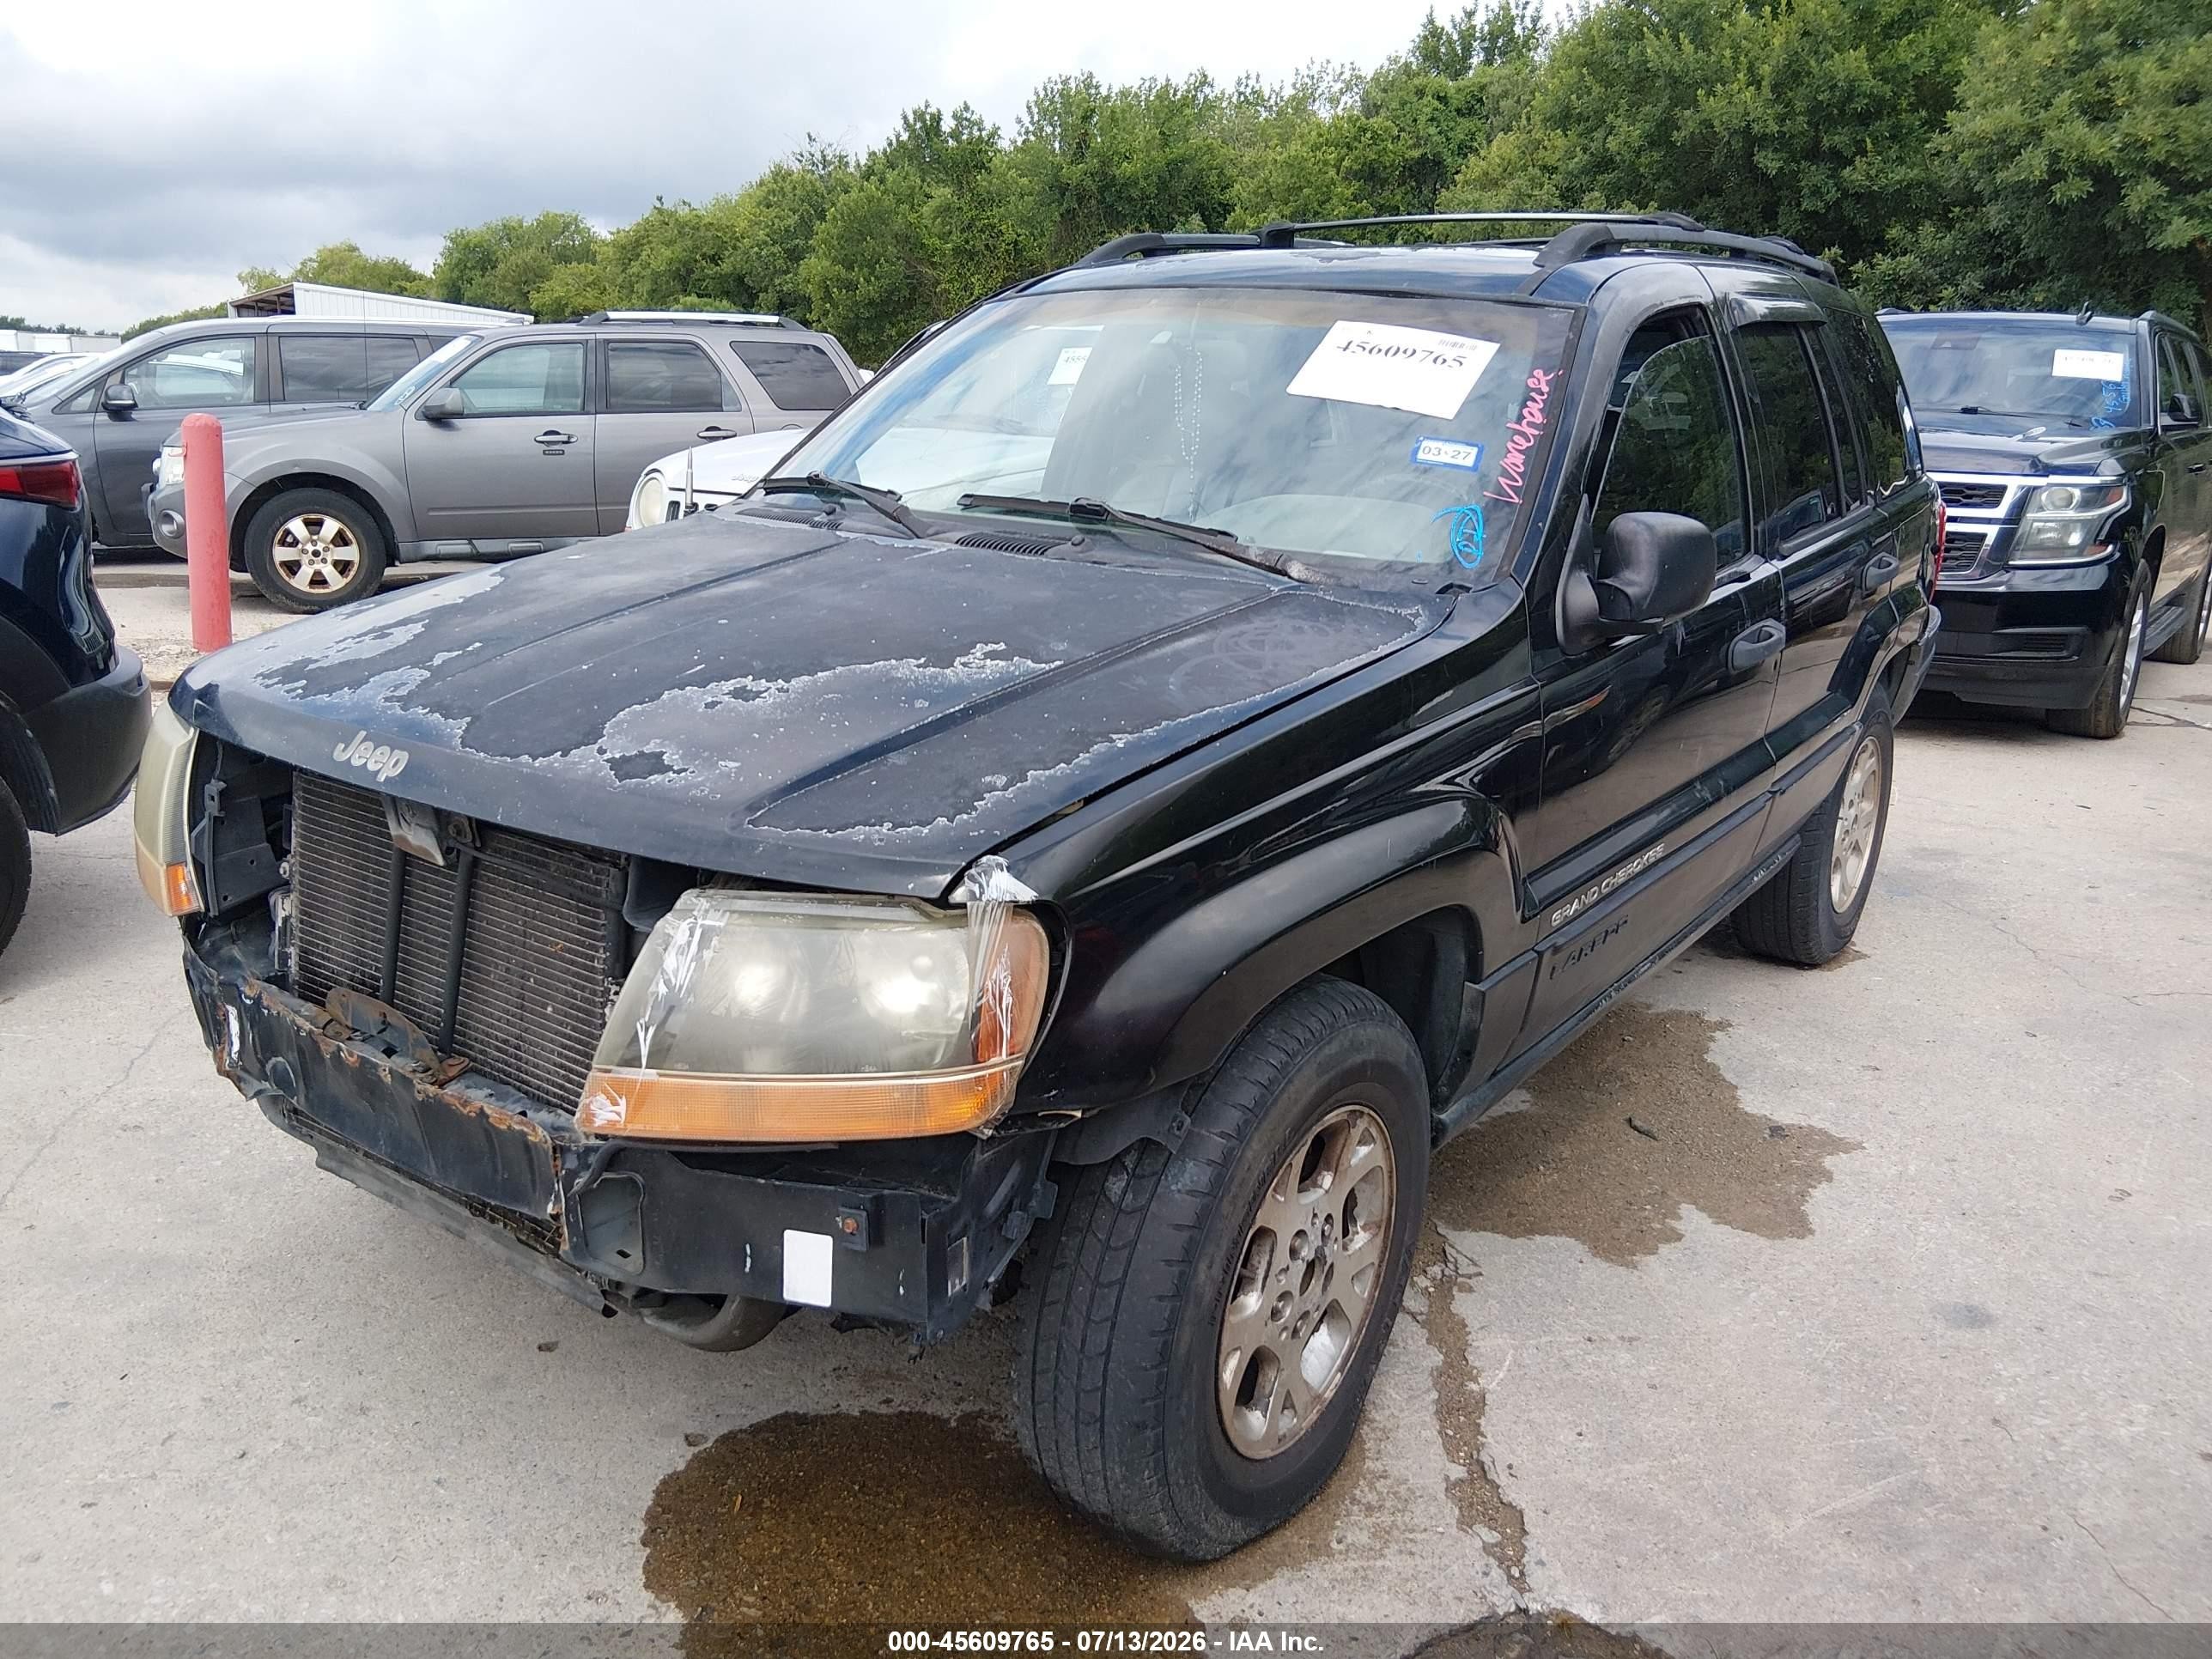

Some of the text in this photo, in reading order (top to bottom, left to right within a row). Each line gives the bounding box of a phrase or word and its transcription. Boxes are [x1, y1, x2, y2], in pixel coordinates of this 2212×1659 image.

[1336, 338, 1468, 369] 45609765
[333, 730, 409, 782] Jeep
[1551, 842, 1666, 927] GRAND CHEROKEE
